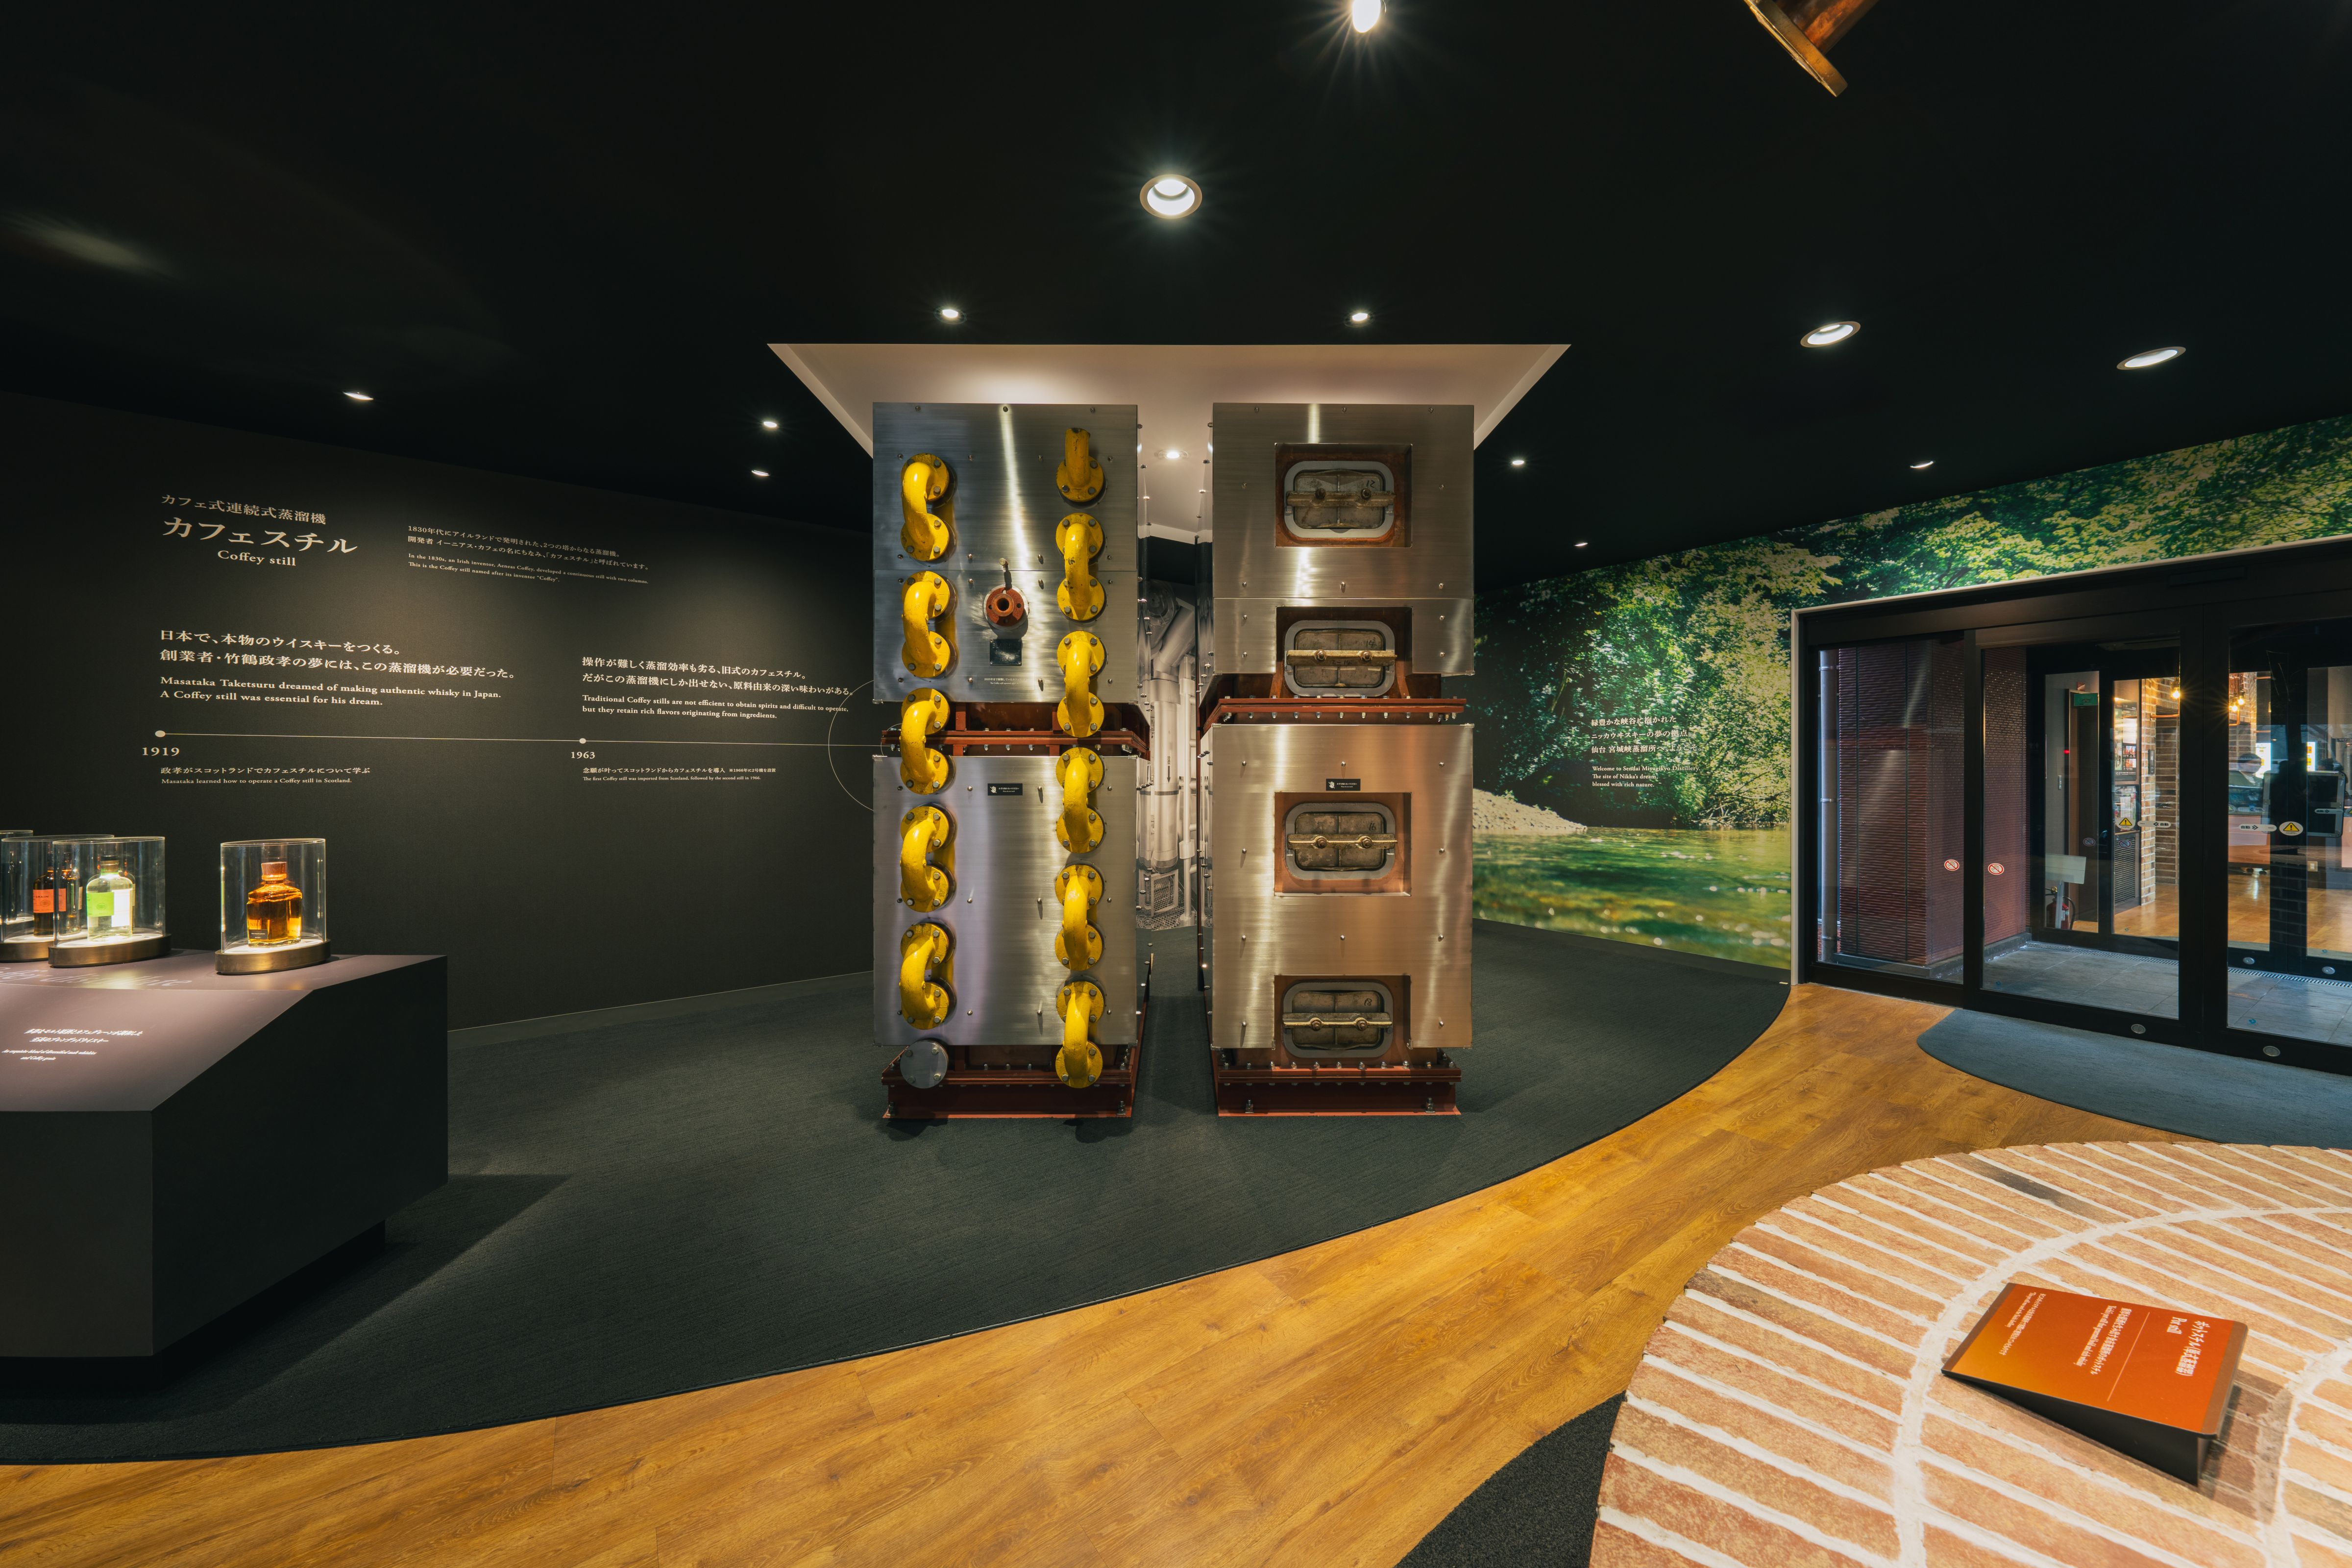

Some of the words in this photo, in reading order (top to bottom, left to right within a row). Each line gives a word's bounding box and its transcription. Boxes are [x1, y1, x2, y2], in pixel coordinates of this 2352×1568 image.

[162, 494, 326, 525] カフェ式連続式蒸溜機
[163, 517, 358, 553] カフェスチル
[408, 536, 434, 545] 開発者
[217, 550, 265, 565] Coffey
[270, 557, 296, 566] still
[160, 677, 216, 686] Masataka
[220, 679, 275, 688] Taketsuru
[278, 682, 324, 690] dreamed
[340, 685, 378, 695] making
[380, 686, 425, 695] authentic
[427, 688, 460, 698] whisky
[473, 690, 501, 699] Japan.
[173, 690, 213, 701] Coffey
[349, 697, 383, 705] dream.
[582, 694, 625, 703] Traditional
[627, 696, 652, 705] Coffey
[825, 704, 849, 713] operate,
[598, 706, 615, 714] they
[682, 710, 720, 718] originating
[1591, 715, 1677, 727] 緑豊かな峡谷に抱かれた
[1591, 729, 1692, 739] ニッカウヰスキーの夢の拠点。
[142, 747, 180, 757] 1919
[2170, 1317, 2188, 1326] Pot
[2167, 1324, 2182, 1335] still
